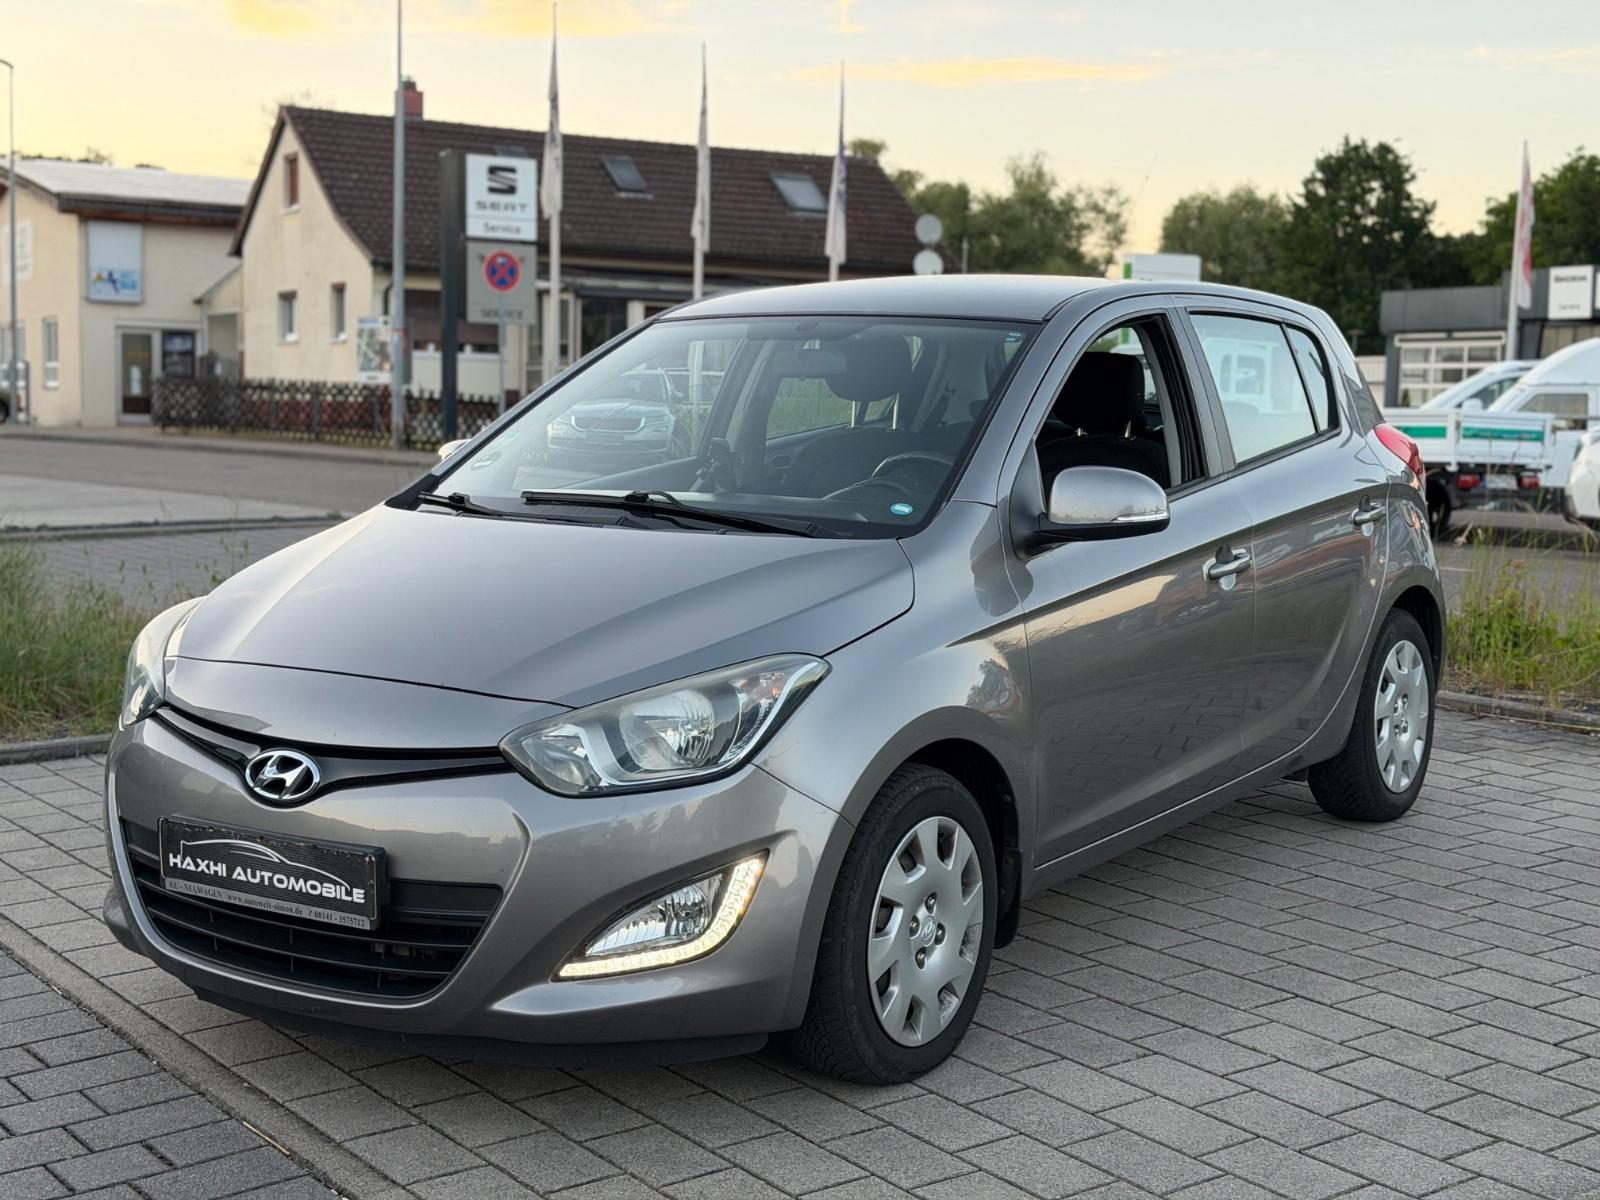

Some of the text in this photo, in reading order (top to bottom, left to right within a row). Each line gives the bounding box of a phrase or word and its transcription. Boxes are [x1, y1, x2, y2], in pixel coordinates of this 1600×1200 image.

[476, 200, 528, 213] SEAT
[483, 222, 521, 235] Service
[169, 853, 366, 904] HAXHI AUTOMOBILE
[184, 883, 223, 899] NEUWAGEN
[314, 911, 333, 921] 08141
